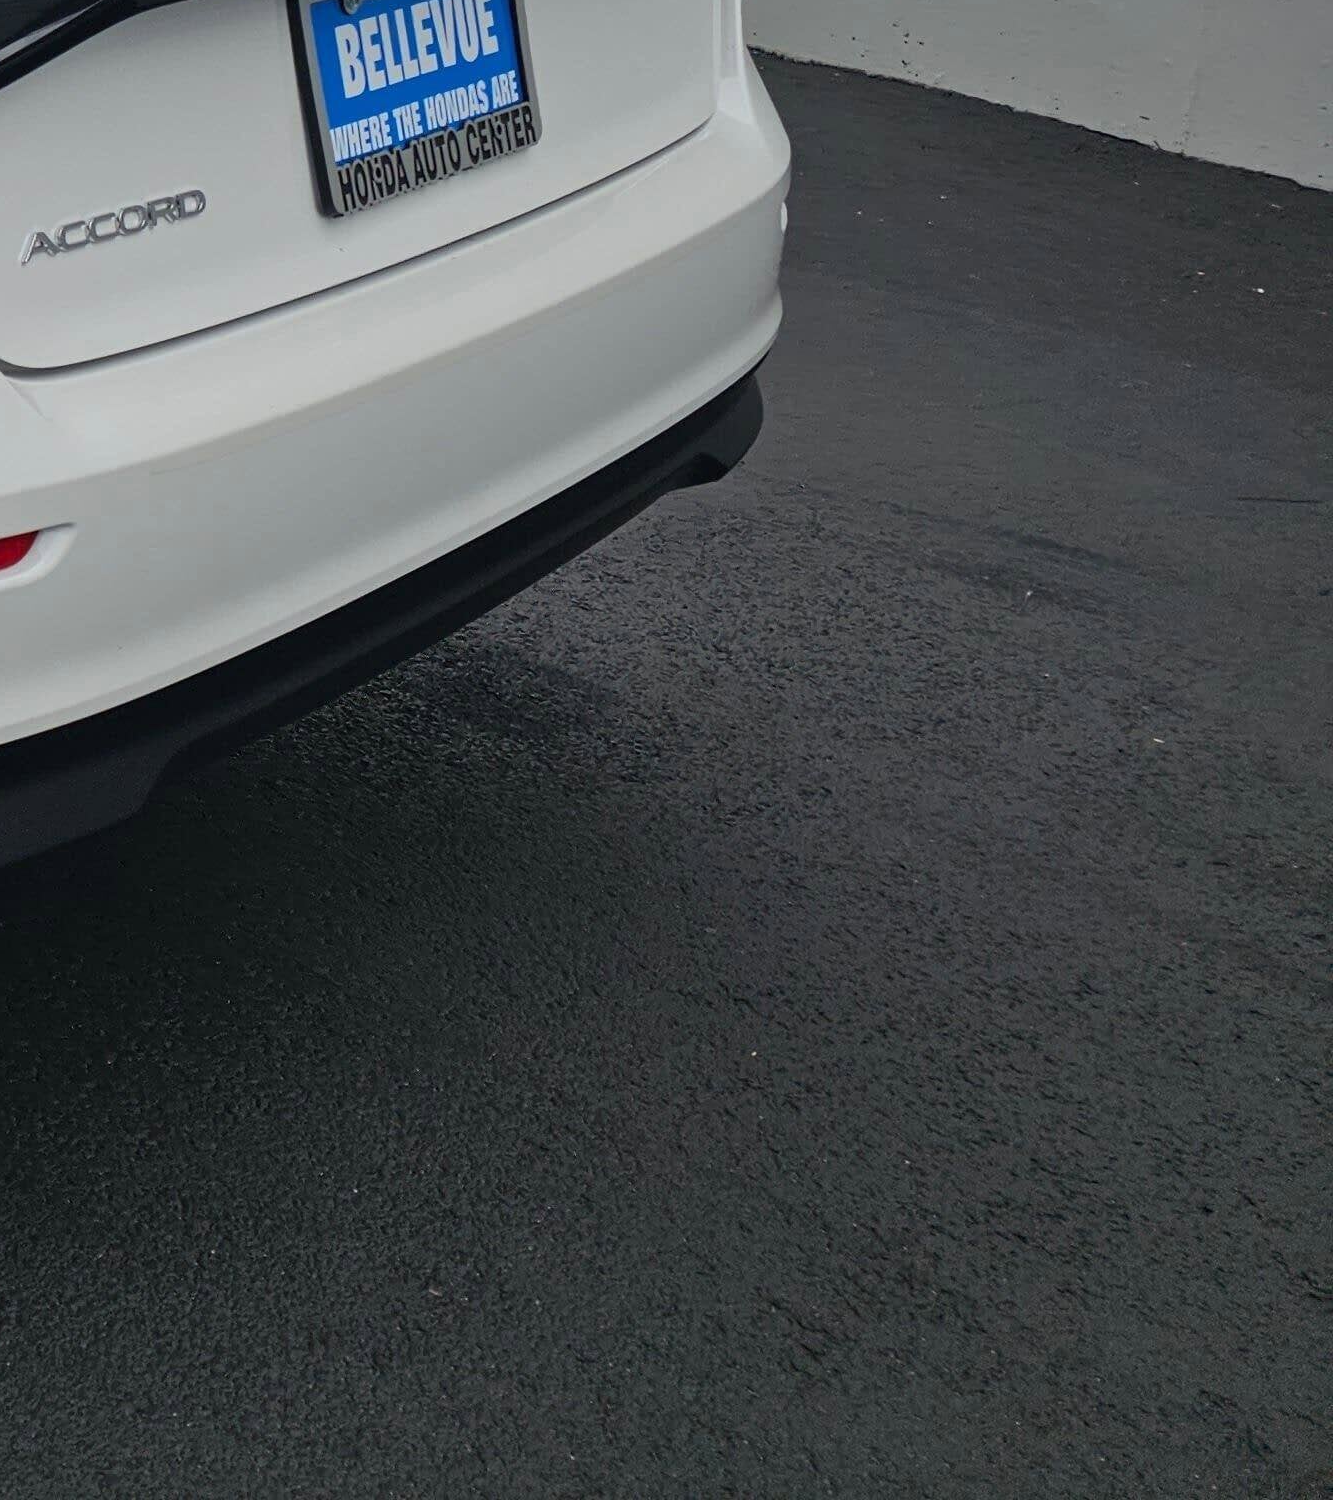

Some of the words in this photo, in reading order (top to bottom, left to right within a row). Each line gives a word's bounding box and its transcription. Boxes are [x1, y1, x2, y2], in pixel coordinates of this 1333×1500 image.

[330, 116, 393, 162] WHERE
[393, 104, 423, 139] THE
[423, 80, 488, 130] HONDAS
[491, 70, 520, 108] ARE
[337, 149, 411, 212] HONDA
[414, 128, 462, 184] AUTO
[465, 104, 538, 164] CENTER
[19, 189, 207, 267] ACCORD
